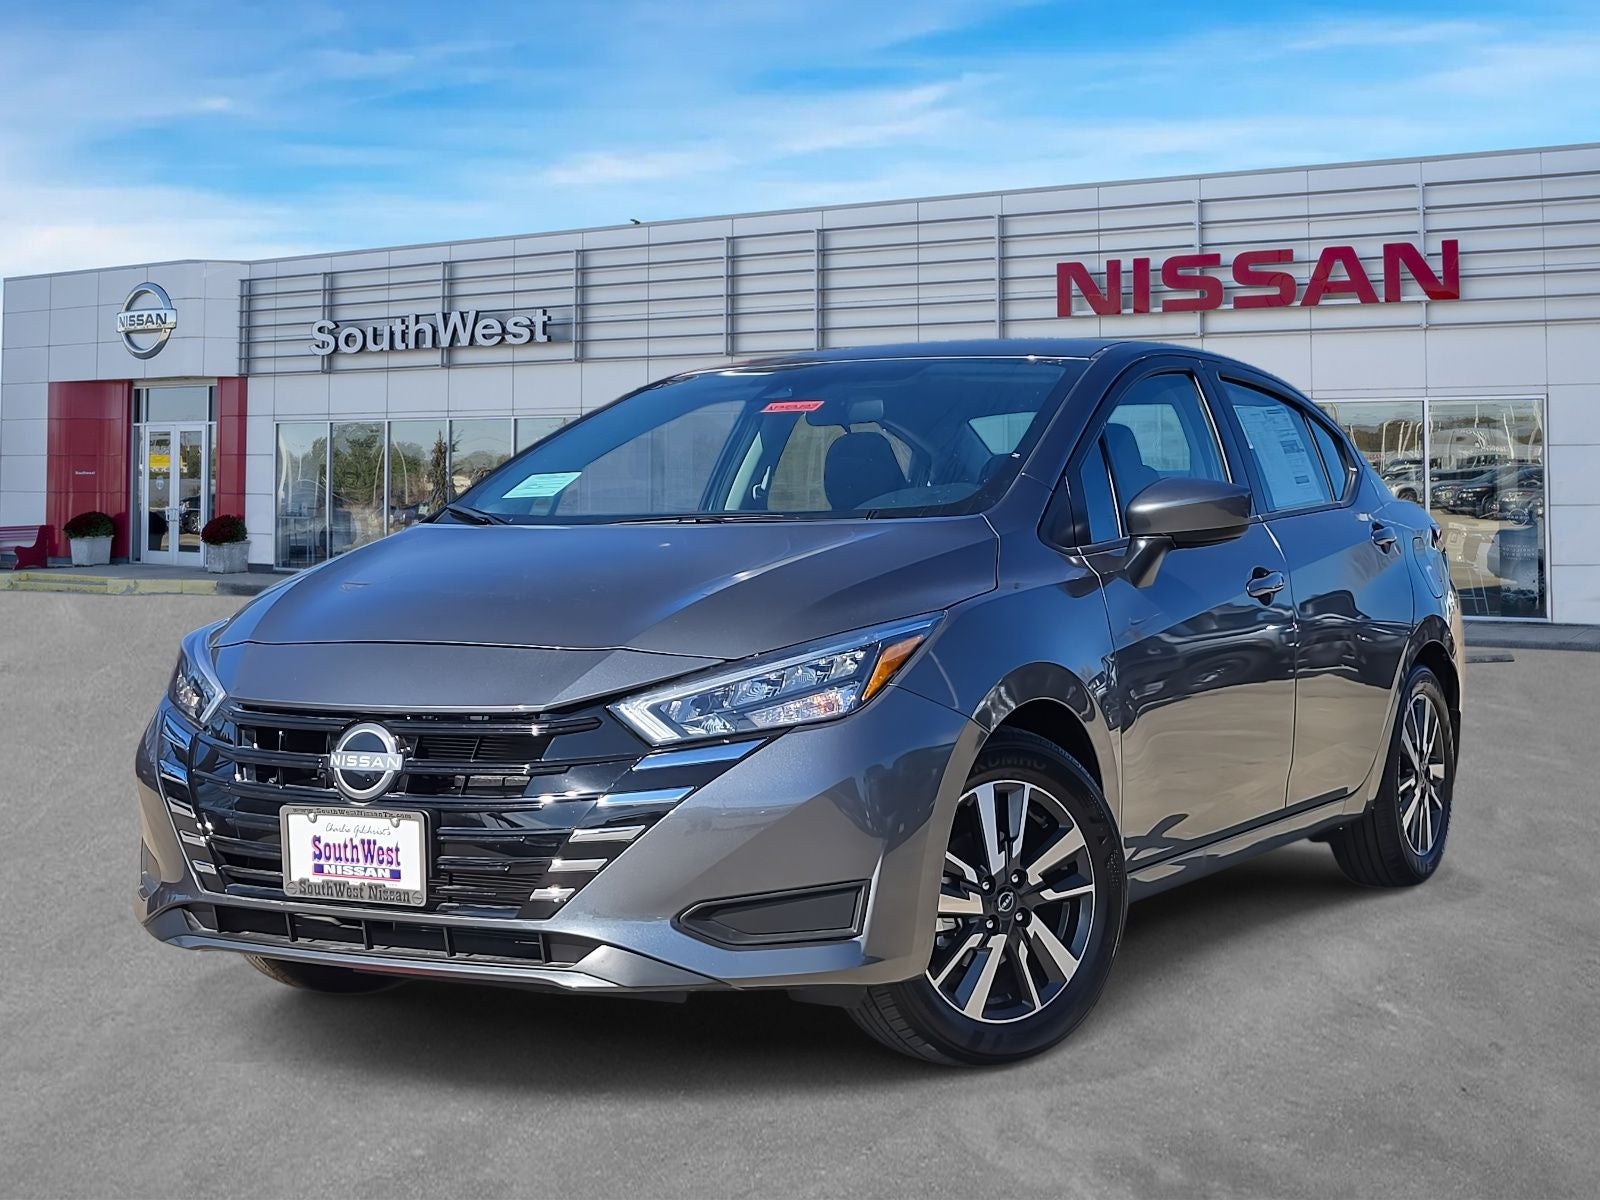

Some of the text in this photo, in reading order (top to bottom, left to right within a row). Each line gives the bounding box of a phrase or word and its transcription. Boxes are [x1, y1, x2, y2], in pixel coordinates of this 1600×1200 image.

[1056, 239, 1460, 318] NISSAN
[119, 312, 167, 328] NISSAN
[309, 308, 551, 356] SouthWest
[330, 753, 399, 768] NISSAN
[312, 834, 401, 867] SouthWest
[323, 864, 390, 878] NISSAN
[298, 879, 411, 904] SouthWest Nissan
